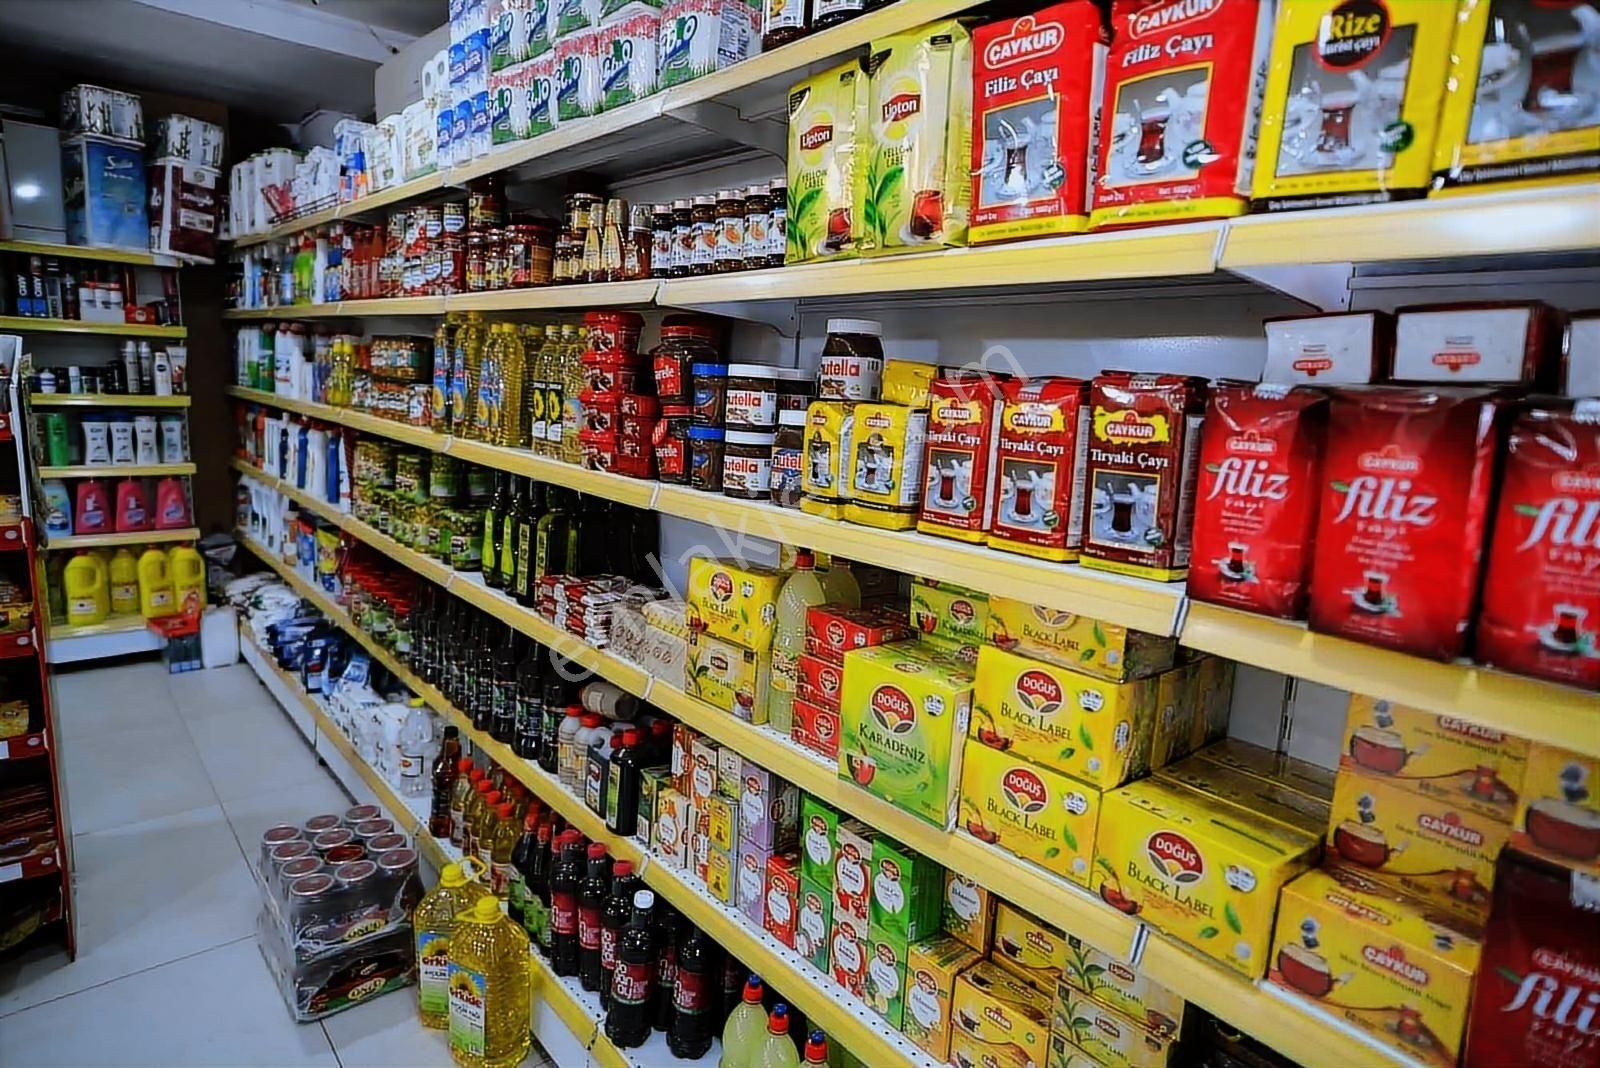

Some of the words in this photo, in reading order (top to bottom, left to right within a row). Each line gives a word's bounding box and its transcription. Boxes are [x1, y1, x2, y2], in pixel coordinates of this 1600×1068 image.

[1331, 13, 1381, 40] Rize
[989, 29, 1058, 65] ÇAYKUR
[1165, 34, 1213, 58] Çayı
[984, 77, 1017, 97] Filiz
[1021, 67, 1058, 91] Çayı
[885, 102, 917, 120] Lipton
[802, 130, 830, 147] Lipton
[728, 392, 762, 407] utella
[1037, 442, 1064, 455] Çayı
[1091, 449, 1134, 465] Tiryaki
[1137, 452, 1168, 469] Çayı
[725, 459, 758, 473] utella
[1206, 457, 1290, 501] filiz
[1333, 475, 1438, 526] filiz
[1023, 624, 1052, 641] BLACK
[1053, 633, 1080, 650] LABEL
[1023, 677, 1057, 696] DOĞUŞ
[877, 692, 909, 715] DOĞUŞ
[1001, 702, 1035, 726] BLACK
[1038, 714, 1073, 741] LABEL
[859, 723, 926, 765] KARADENİZ
[1009, 774, 1042, 797] DOĞUŞ
[987, 798, 1021, 825] BLACK
[1024, 814, 1058, 841] LABEL
[1155, 837, 1198, 867] DOĞUŞ
[1128, 861, 1170, 896] BLACK
[1174, 885, 1217, 920] LABEL
